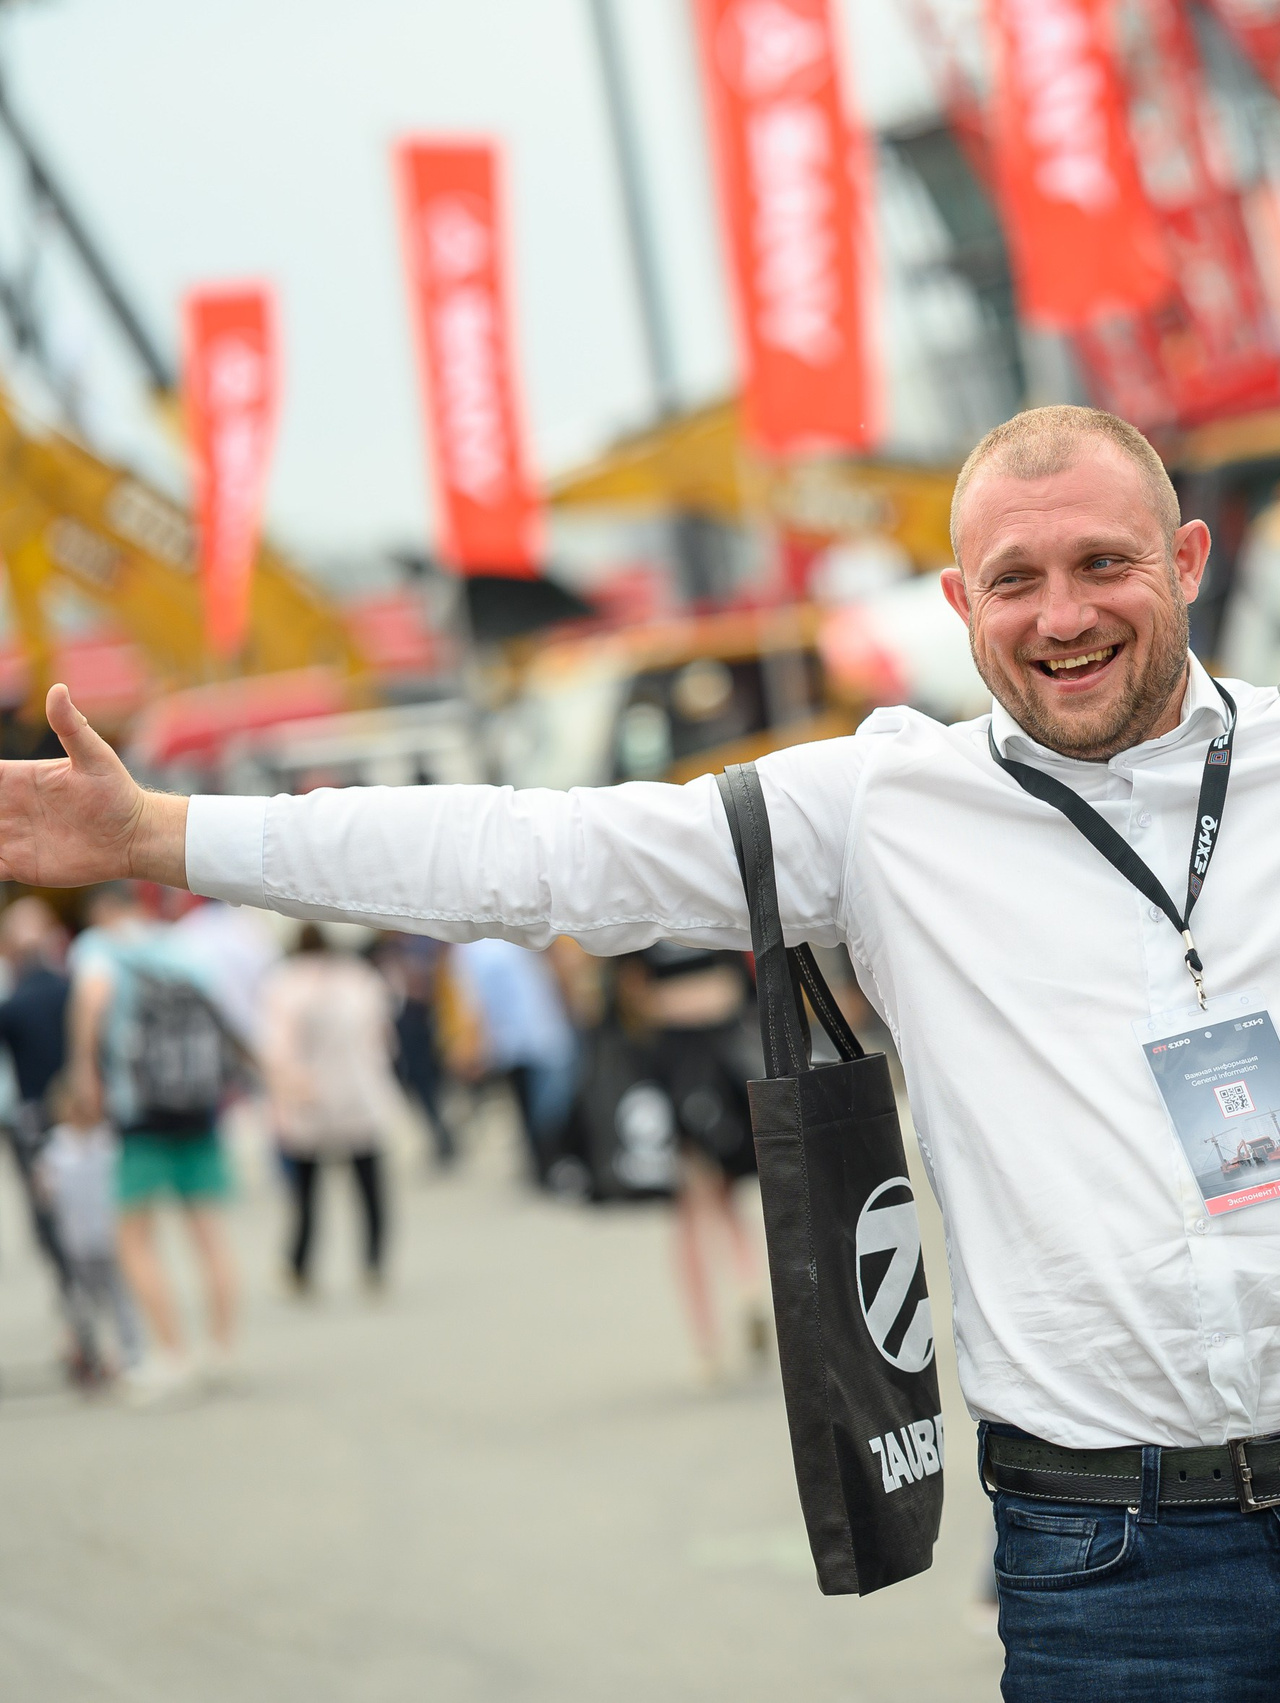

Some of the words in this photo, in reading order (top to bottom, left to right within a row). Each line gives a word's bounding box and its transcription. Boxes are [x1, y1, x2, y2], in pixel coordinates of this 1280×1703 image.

[1152, 1044, 1167, 1054] CTT
[1168, 1038, 1191, 1050] EXPO
[1184, 1068, 1213, 1081] Важная
[1213, 1055, 1259, 1072] информация
[1191, 1075, 1218, 1087] General
[1227, 1188, 1273, 1206] Экспонент
